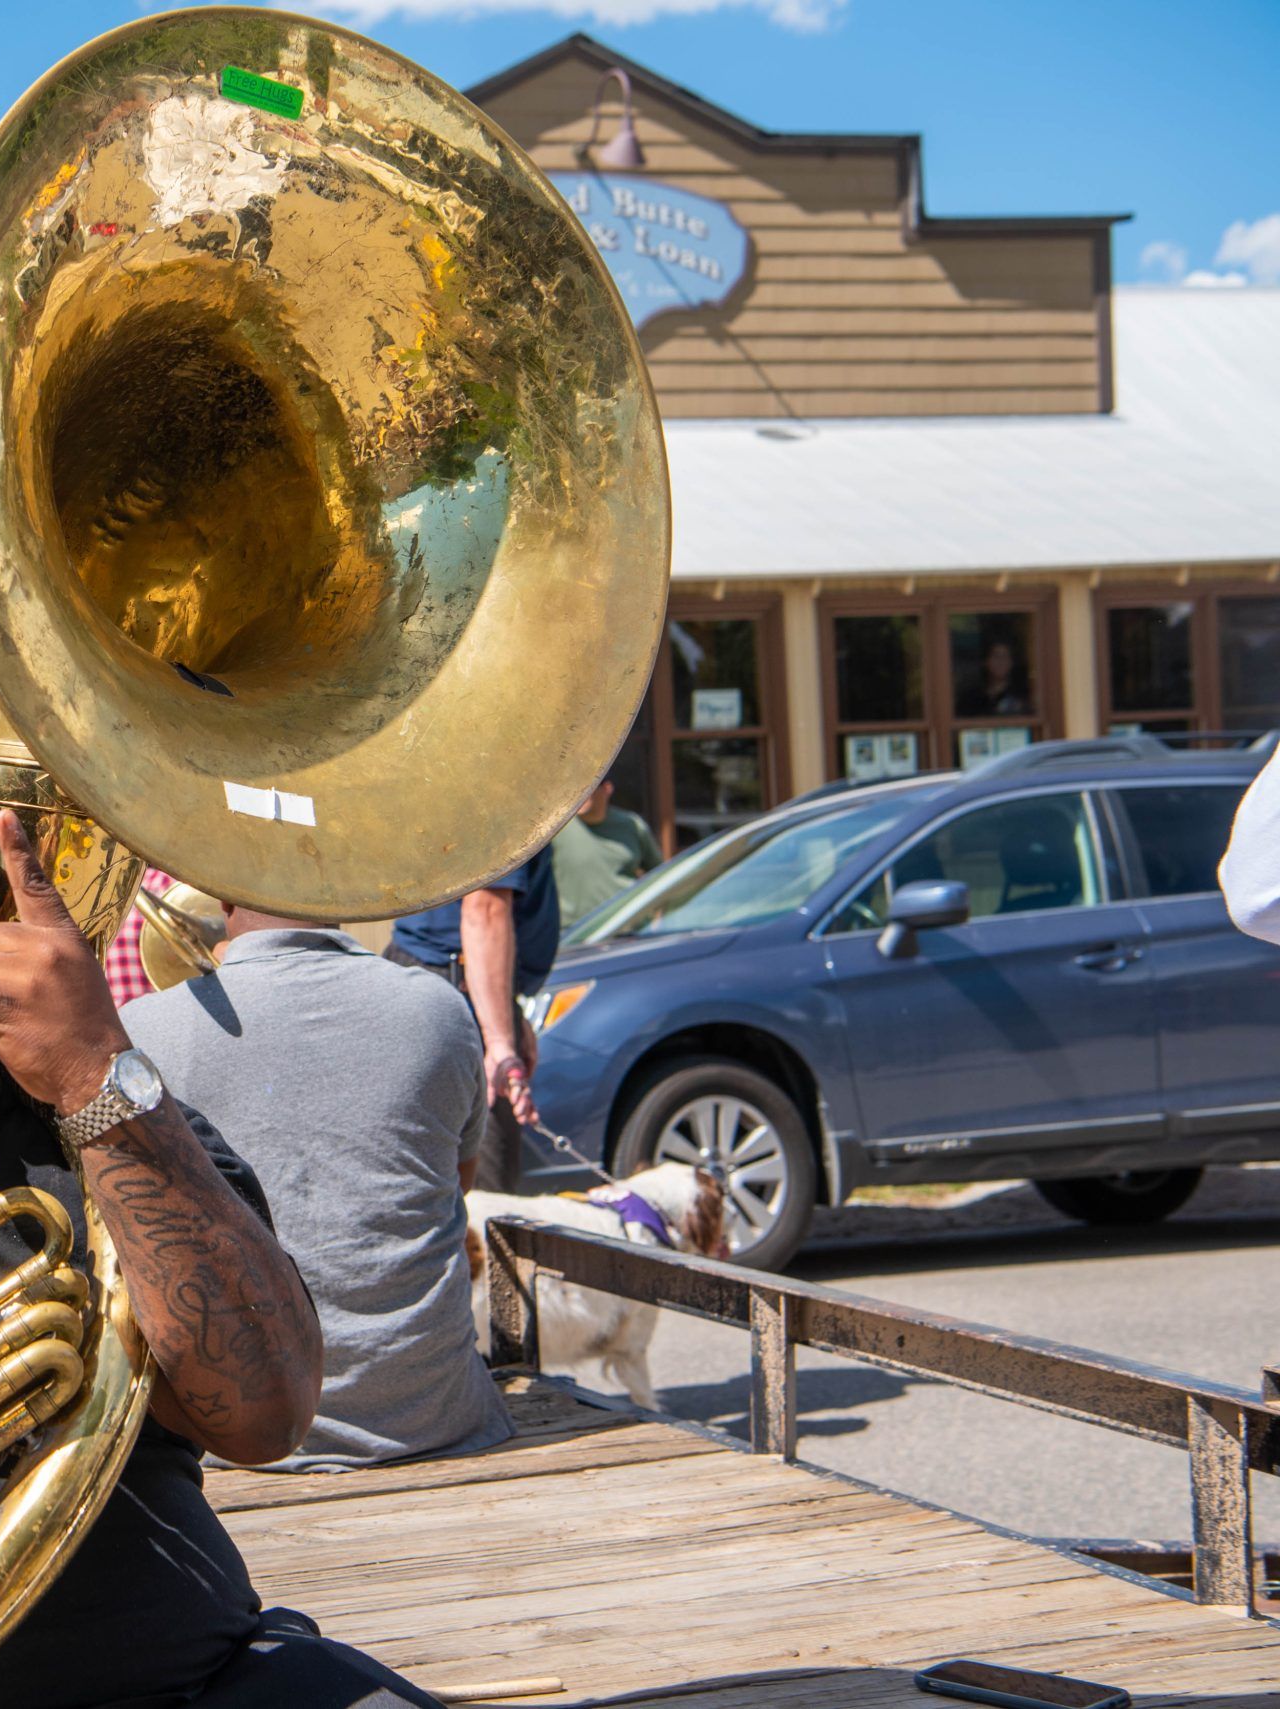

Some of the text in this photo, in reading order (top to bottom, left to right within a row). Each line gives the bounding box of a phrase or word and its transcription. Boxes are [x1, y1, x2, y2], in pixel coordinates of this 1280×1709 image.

[228, 70, 295, 104] Free Hugs
[613, 186, 708, 239] Butte
[590, 223, 721, 280] & Loan
